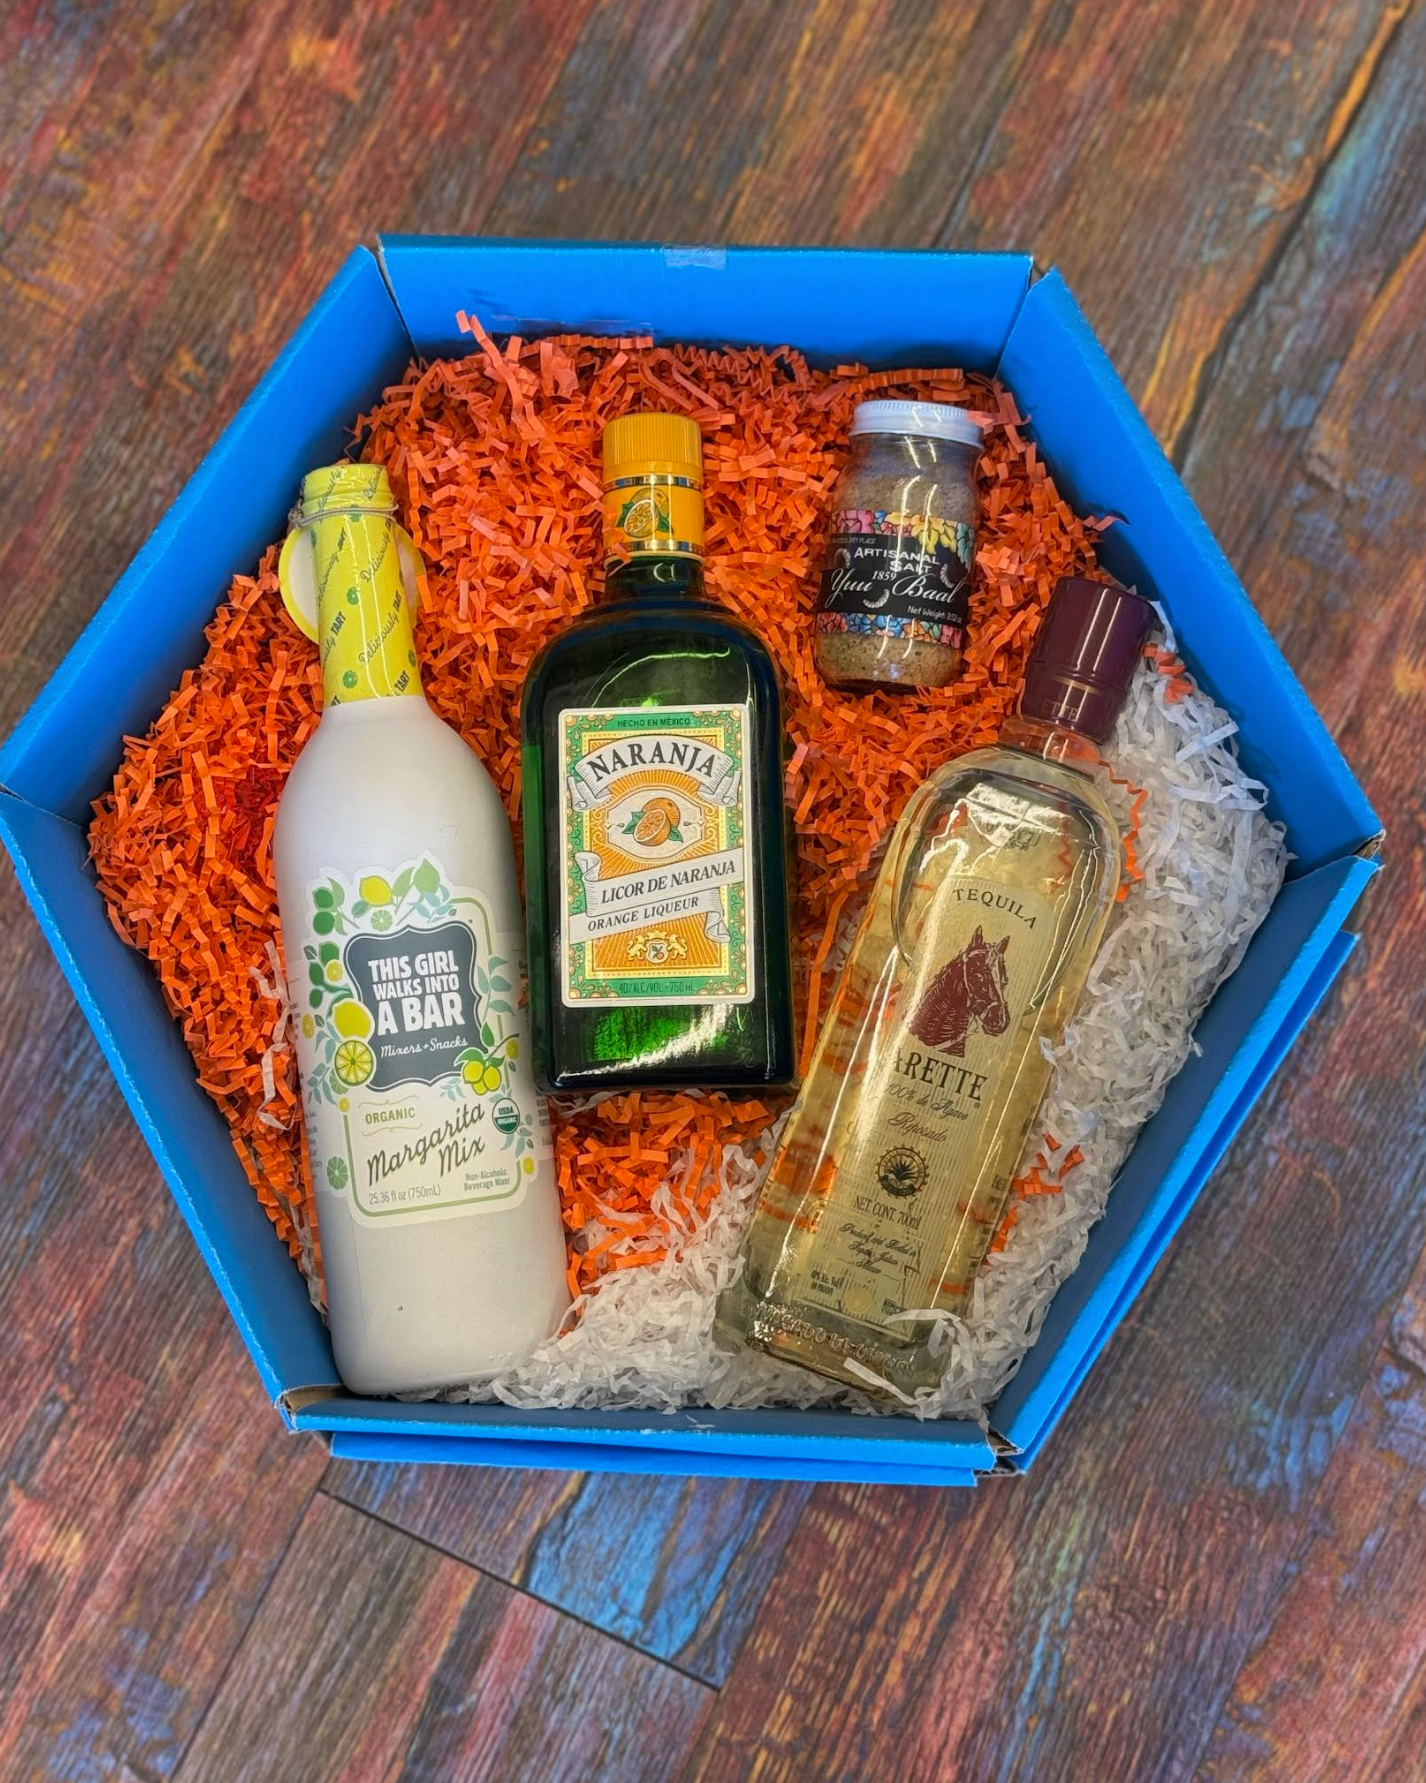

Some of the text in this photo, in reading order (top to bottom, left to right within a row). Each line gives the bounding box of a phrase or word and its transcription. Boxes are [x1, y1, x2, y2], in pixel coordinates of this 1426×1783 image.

[854, 547, 940, 565] ARTISANAL
[889, 560, 932, 575] SALT
[872, 570, 898, 582] 1859
[892, 573, 967, 604] Baal
[907, 605, 922, 615] Net
[330, 611, 346, 636] TART
[358, 612, 399, 665] Deliciously
[394, 670, 411, 693] TART
[617, 719, 645, 728] HECHO
[647, 718, 657, 727] EN
[586, 741, 716, 783] NARANJA
[601, 860, 736, 905] LICOR DE NARANJA
[587, 896, 700, 932] ORANGE LIQUEUR
[952, 887, 1038, 930] TEQUILA
[368, 949, 459, 982] THIS GIRL
[372, 973, 460, 1001] WALKS INTO
[377, 991, 466, 1036] A BAR
[916, 1092, 931, 1107] de
[365, 1107, 417, 1125] ORGANIC
[887, 1111, 949, 1143] Reposado
[367, 1103, 486, 1187] Margarita
[438, 1136, 486, 1178] Mix
[369, 1183, 442, 1205] 25.36 fl oz (750mL)
[464, 1177, 511, 1191] Beverage Mixer
[873, 1202, 897, 1222] CONT.
